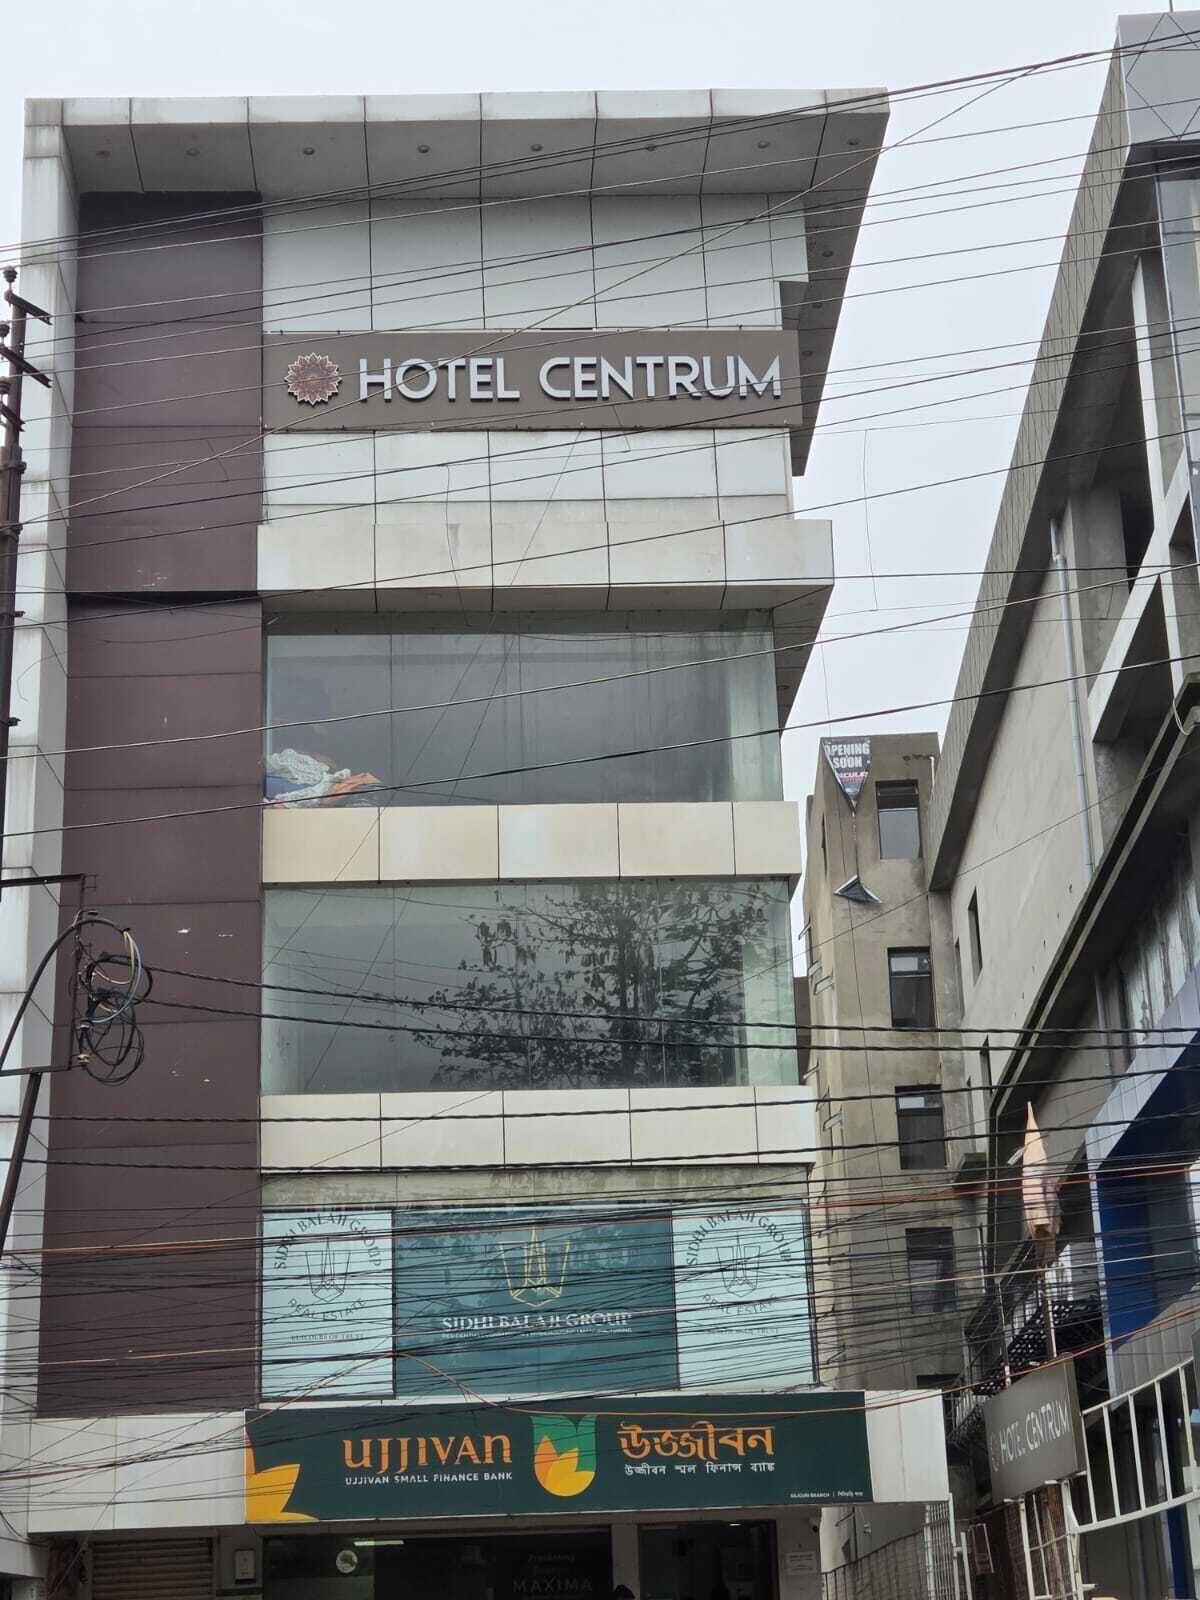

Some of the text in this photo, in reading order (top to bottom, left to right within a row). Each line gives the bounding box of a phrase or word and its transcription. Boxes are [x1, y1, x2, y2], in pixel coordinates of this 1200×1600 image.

[359, 353, 783, 402] HOTEL CENTRUM
[832, 756, 863, 769] SOON
[1025, 1397, 1071, 1451] CENTRUM
[345, 1471, 513, 1486] UJJIVAN SMALL FINANCE BANK
[512, 1576, 593, 1593] MAXIMA
